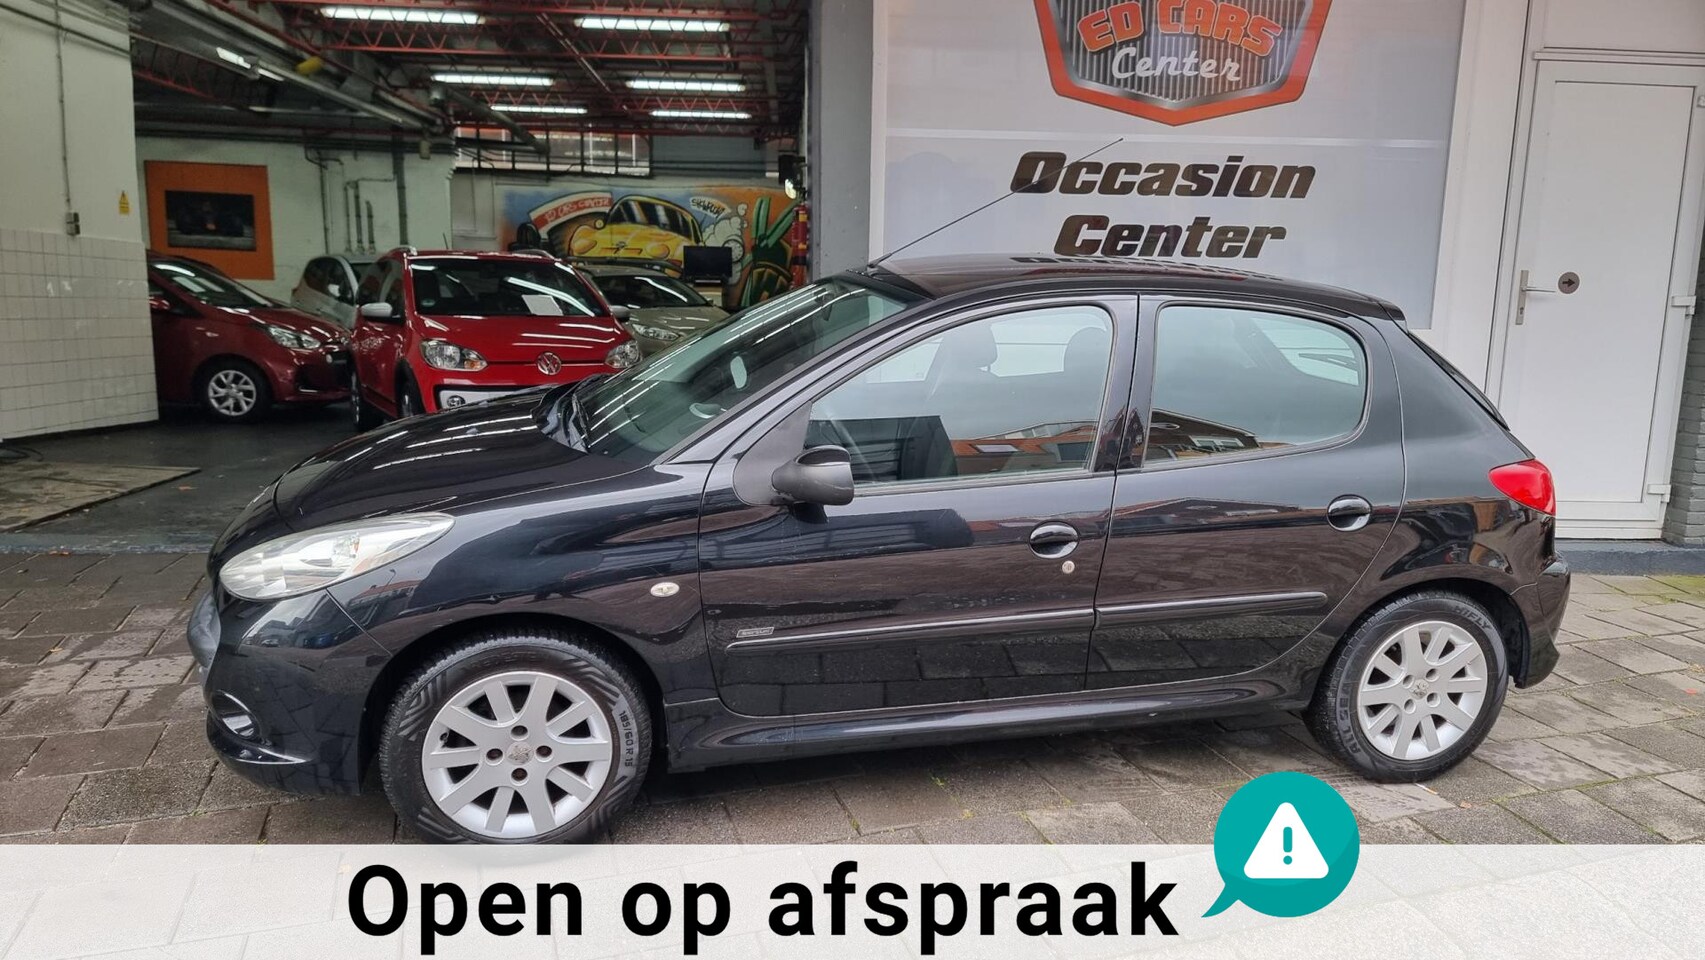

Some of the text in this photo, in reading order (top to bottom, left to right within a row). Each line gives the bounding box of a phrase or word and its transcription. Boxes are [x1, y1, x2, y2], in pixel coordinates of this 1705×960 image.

[1077, 0, 1283, 57] ED CARS
[1112, 47, 1241, 81] Center
[1010, 151, 1316, 199] Occasion
[1053, 214, 1287, 259] Center
[619, 710, 634, 746] 185/60
